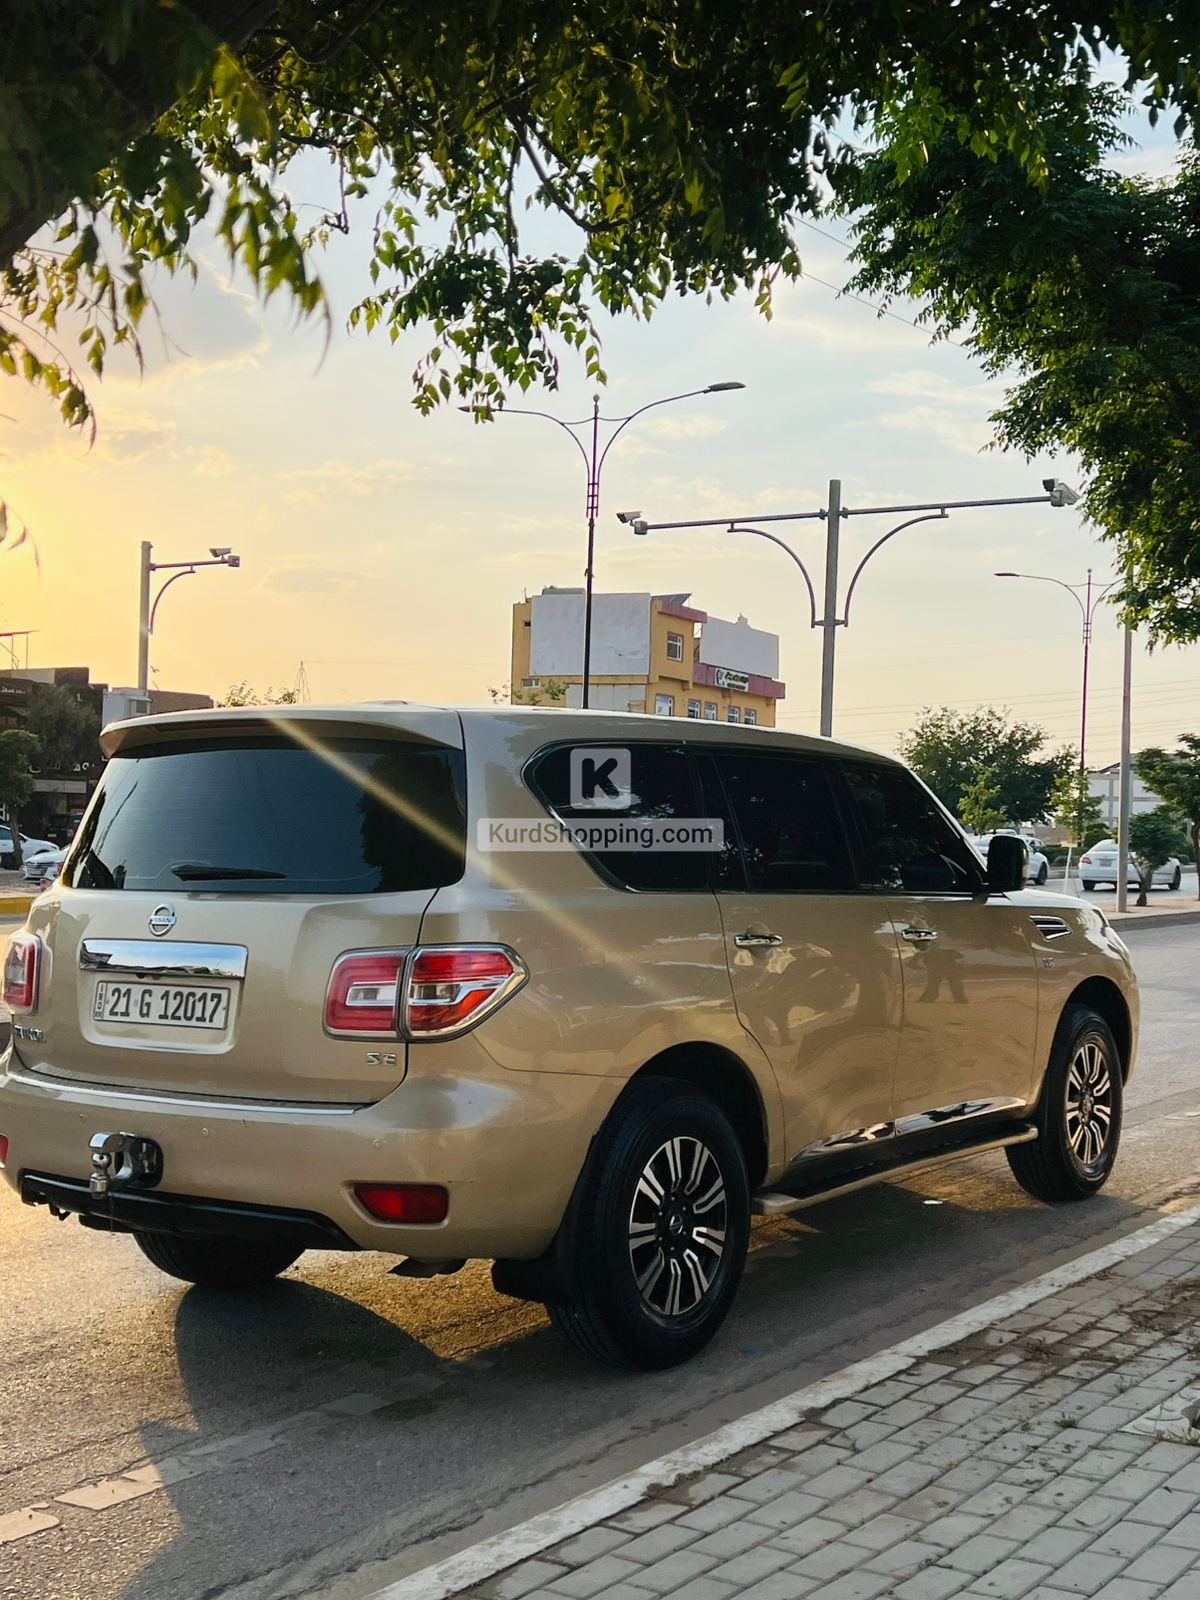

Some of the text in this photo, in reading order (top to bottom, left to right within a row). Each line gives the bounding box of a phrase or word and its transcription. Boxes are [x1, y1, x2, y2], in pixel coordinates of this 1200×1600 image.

[109, 987, 222, 1023] 21 G 12017
